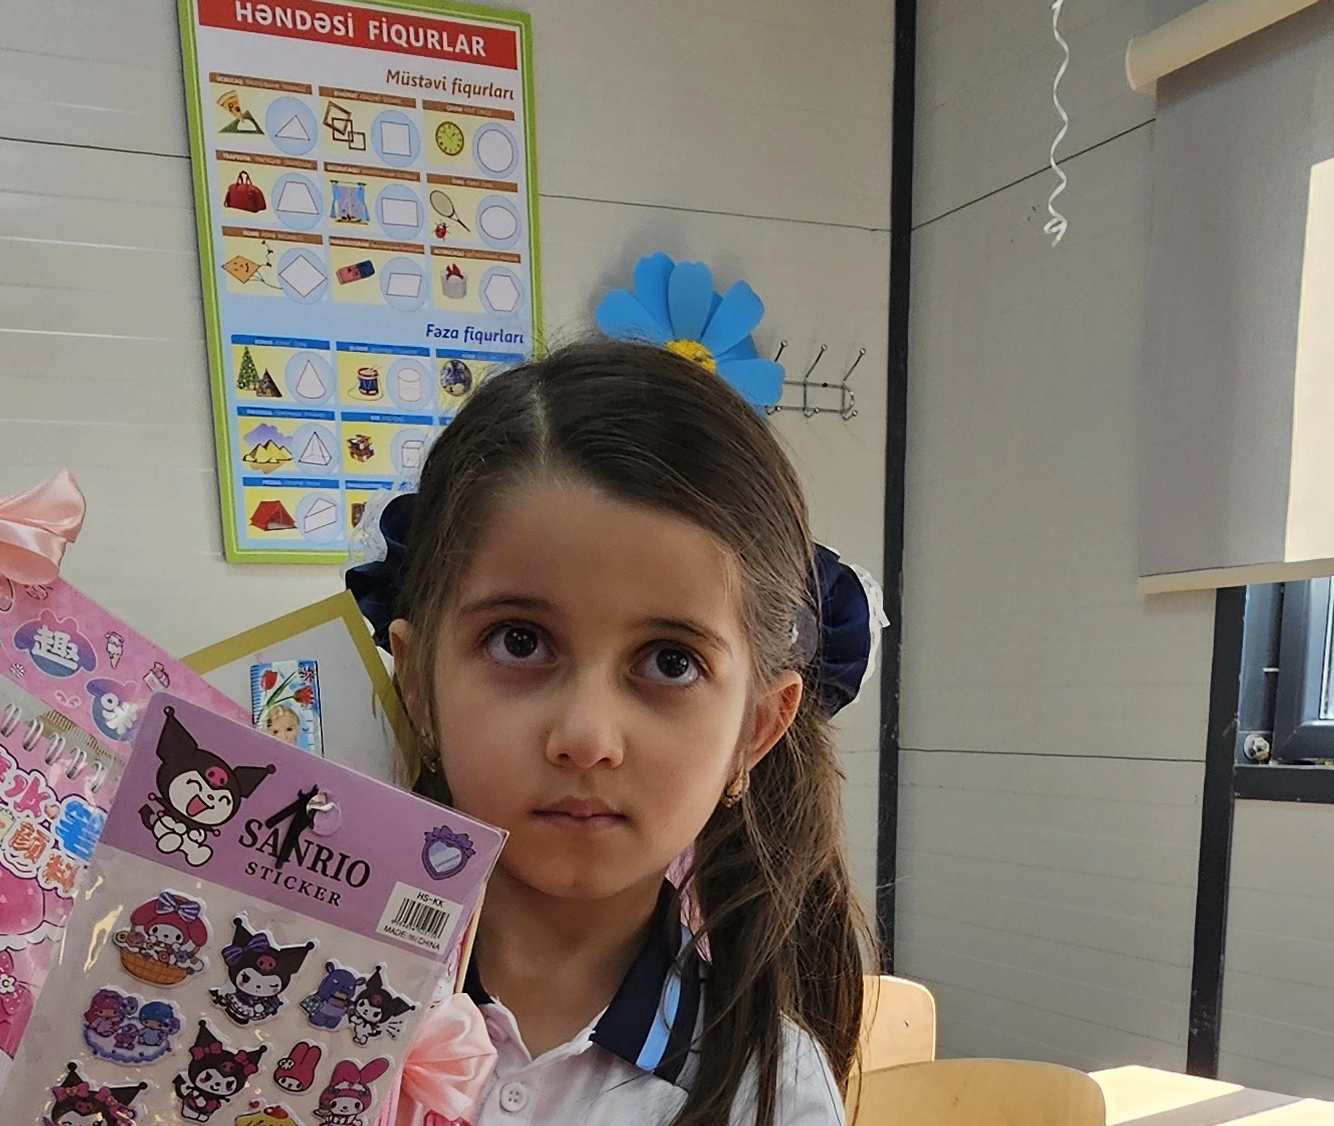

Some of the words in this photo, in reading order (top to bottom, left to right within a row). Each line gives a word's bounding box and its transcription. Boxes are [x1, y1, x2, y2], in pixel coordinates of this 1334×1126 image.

[235, 0, 354, 37] HƏNDƏSİ
[369, 17, 486, 56] FİQURLAR
[386, 69, 447, 91] Müstəvi
[451, 77, 514, 100] fiqurları
[426, 323, 459, 339] Fəza
[464, 326, 524, 344] fiqurları
[238, 818, 371, 888] SANRIO
[244, 861, 342, 906] STICKER
[384, 925, 407, 939] MADE
[418, 937, 441, 951] CHINA
